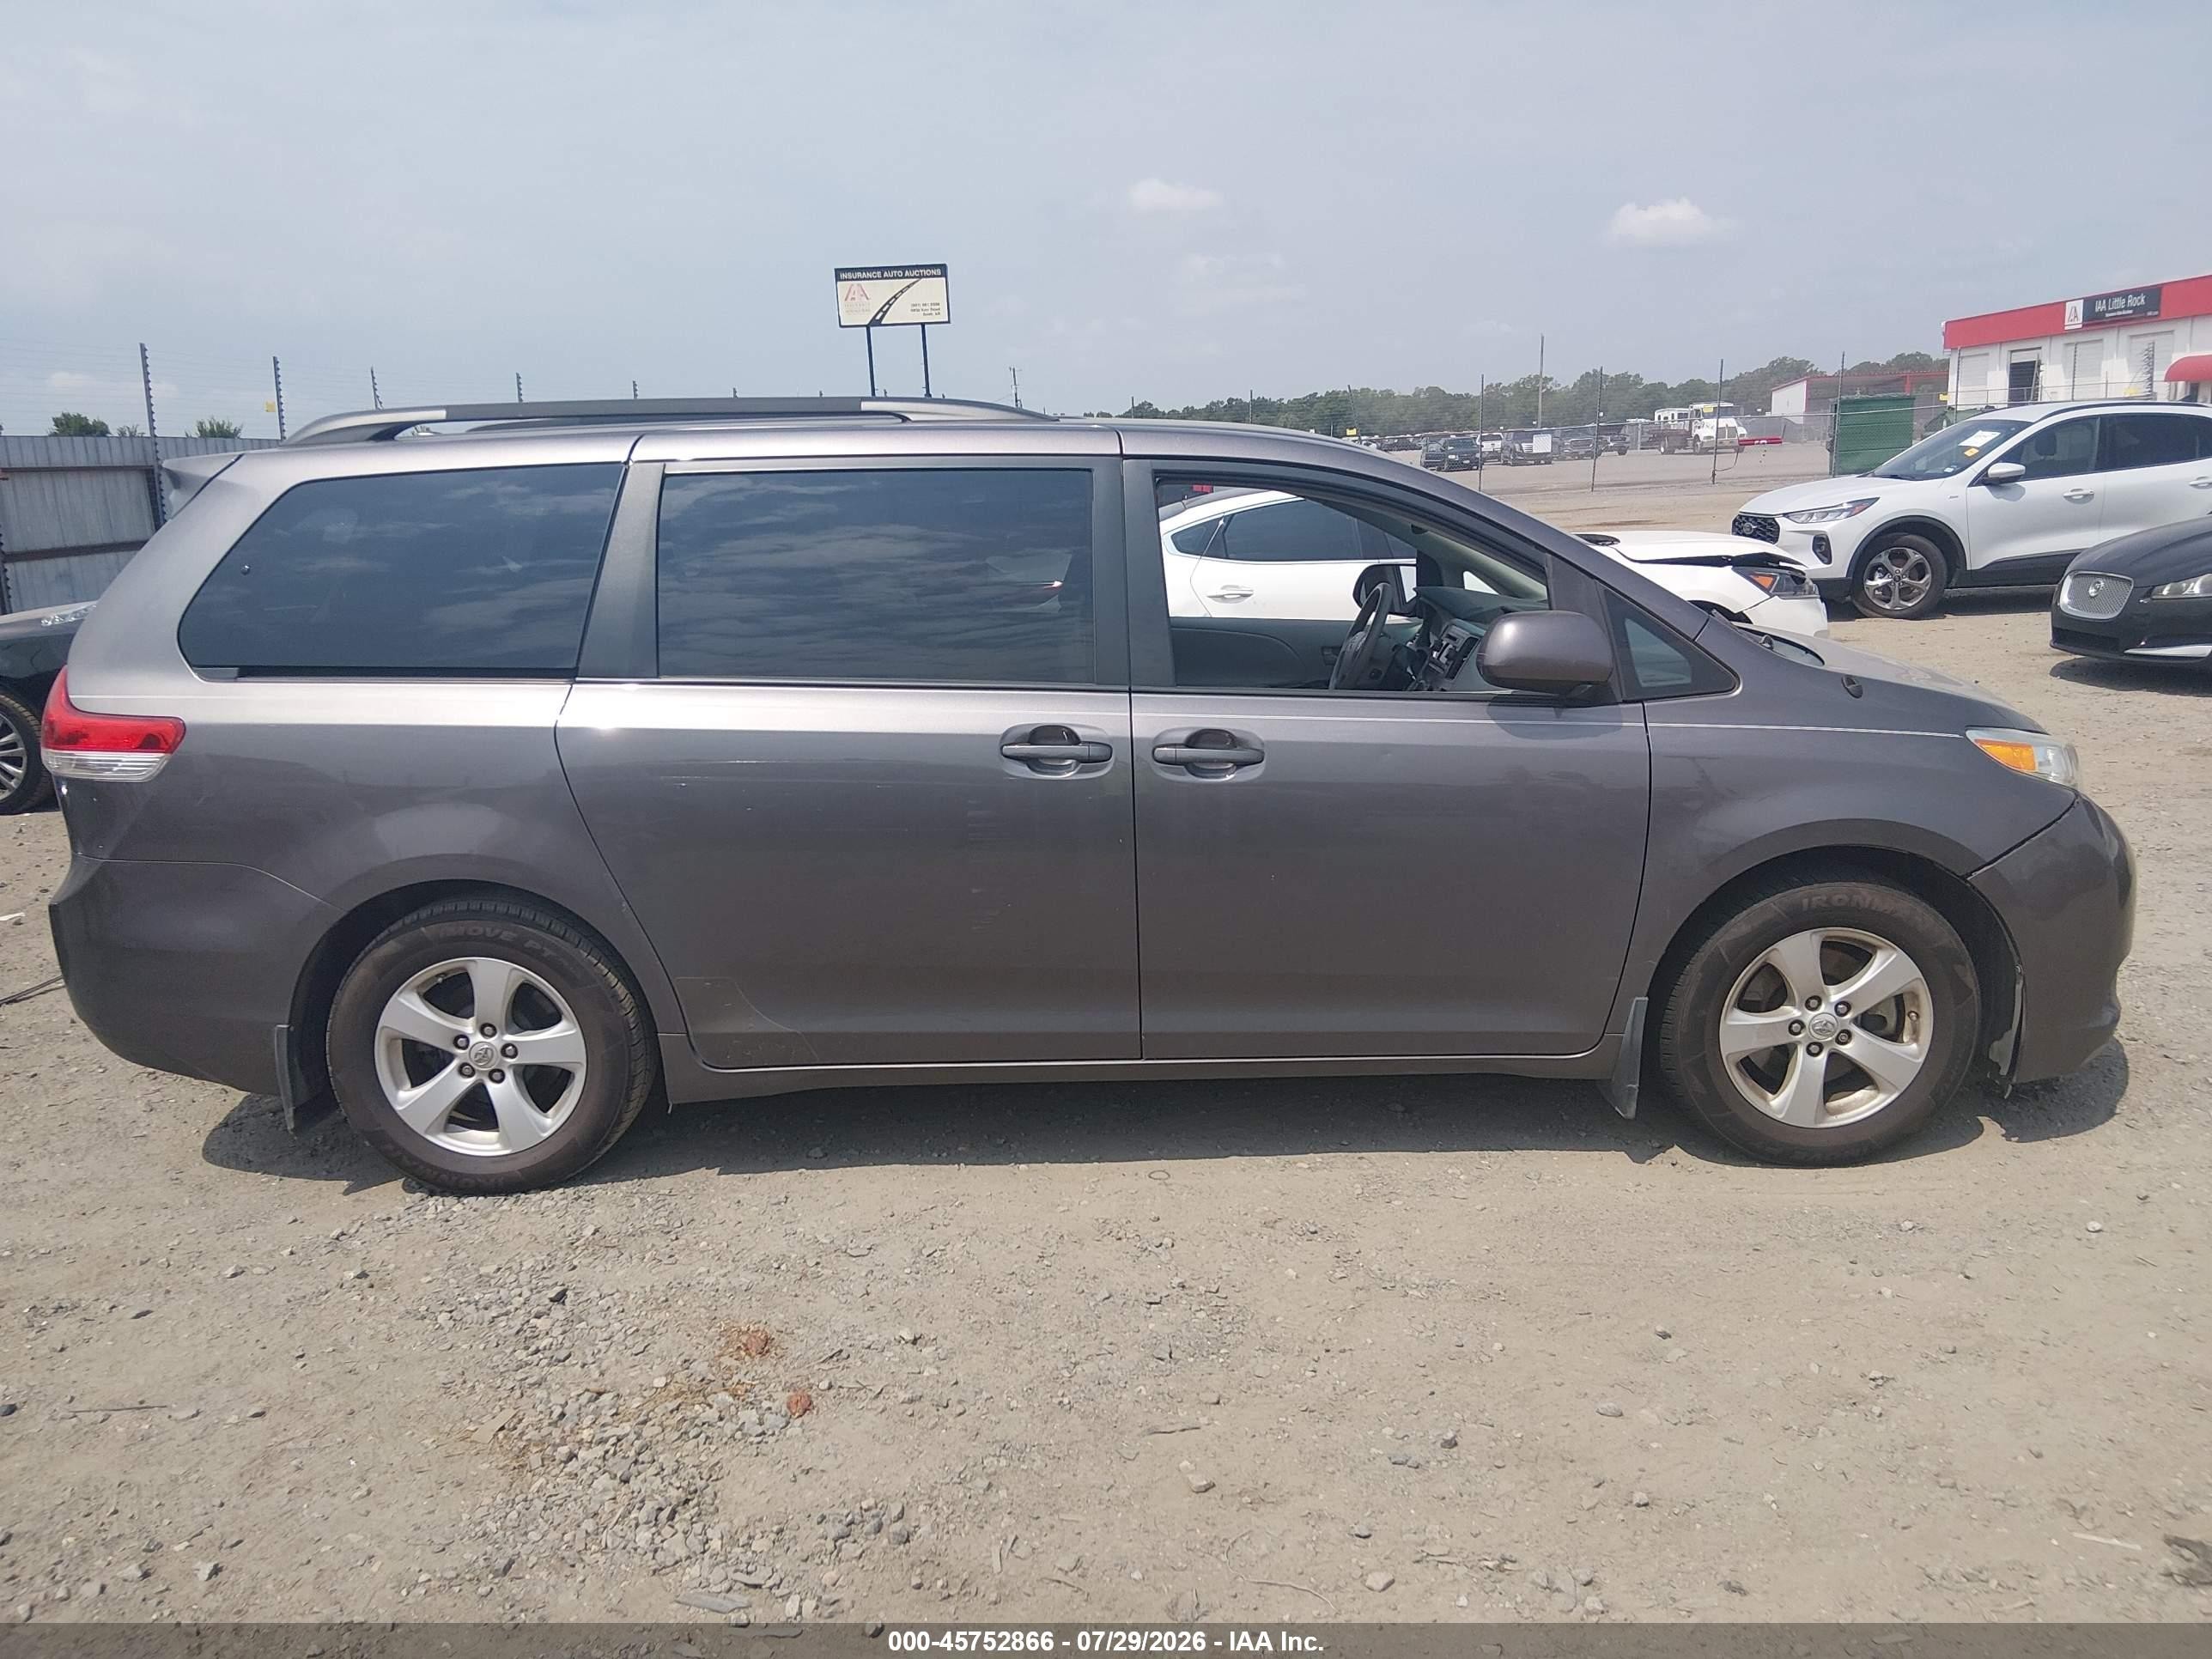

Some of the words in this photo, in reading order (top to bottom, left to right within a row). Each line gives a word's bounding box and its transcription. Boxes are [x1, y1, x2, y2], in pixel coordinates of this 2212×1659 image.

[840, 270, 882, 280] INSURANCE
[904, 269, 942, 277] AUCTIONS
[2094, 299, 2106, 313] IAA
[2108, 296, 2126, 310] Little
[2127, 293, 2146, 307] Rock
